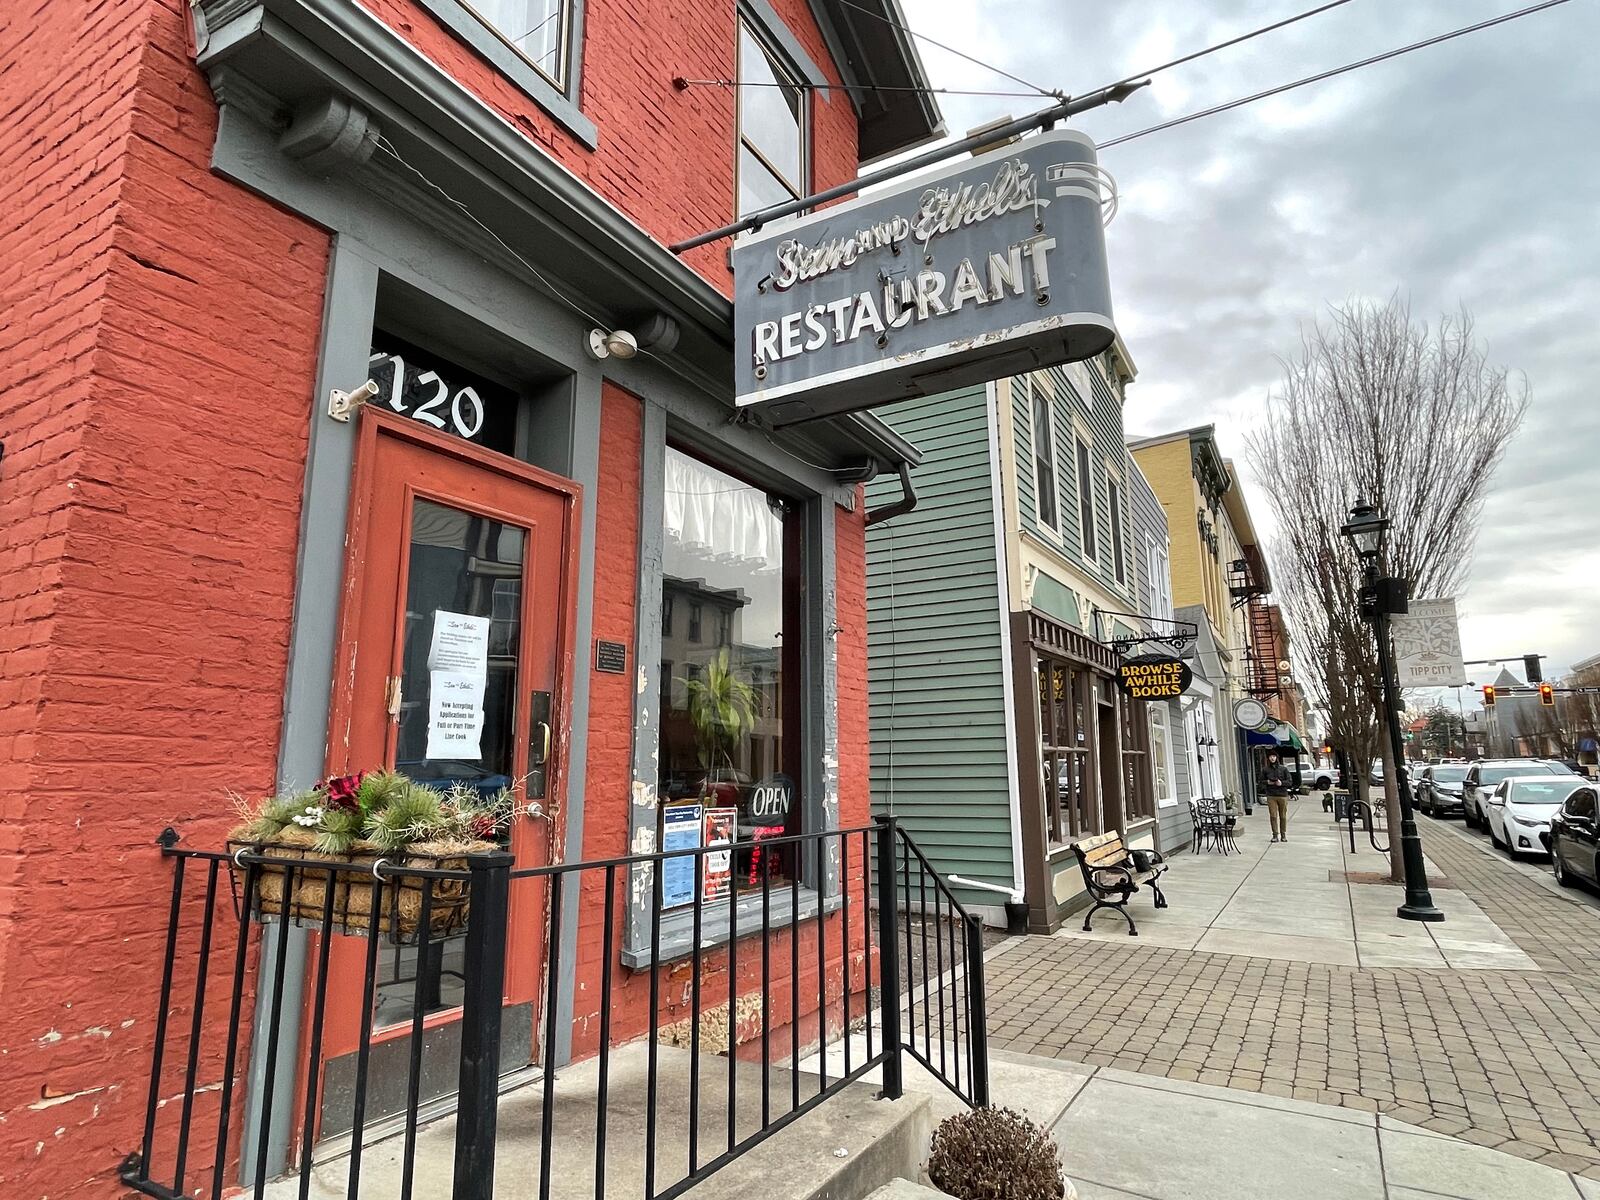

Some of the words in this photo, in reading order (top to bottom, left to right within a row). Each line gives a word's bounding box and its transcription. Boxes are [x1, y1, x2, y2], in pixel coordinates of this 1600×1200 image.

[753, 234, 1058, 366] RESTAURANT
[388, 354, 484, 439] 120
[1121, 662, 1184, 677] BROWSE
[1409, 666, 1430, 676] TIPP
[1431, 665, 1453, 675] CITY
[1125, 673, 1182, 687] AWHILE
[1131, 684, 1182, 698] BOOKS
[437, 721, 447, 729] Full
[444, 732, 455, 740] Line
[752, 787, 791, 817] OPEN
